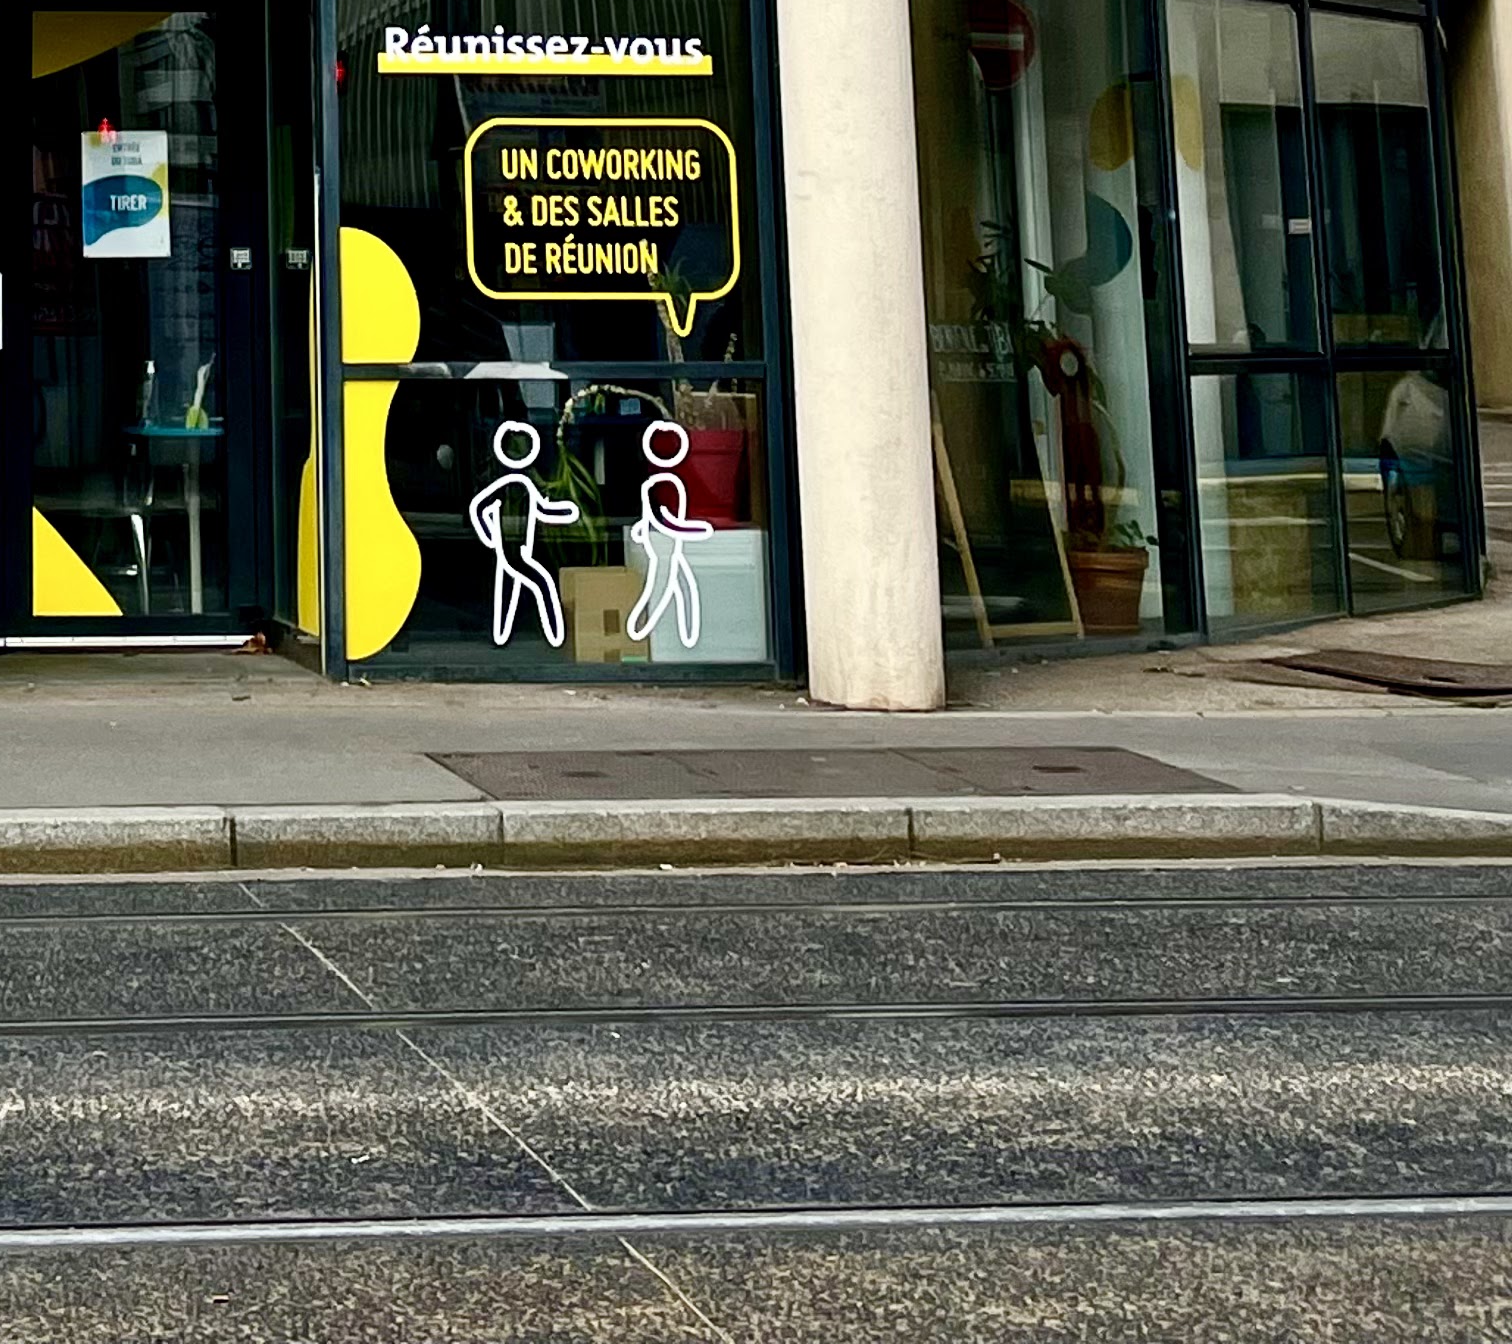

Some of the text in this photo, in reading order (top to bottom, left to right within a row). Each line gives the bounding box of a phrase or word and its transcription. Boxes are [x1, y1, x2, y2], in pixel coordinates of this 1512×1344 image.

[384, 25, 704, 67] Réunissez-vous
[501, 147, 702, 182] UN COWORKING
[109, 194, 147, 211] TIRER
[502, 194, 680, 228] & DES SALLES
[504, 234, 660, 276] DE RÉUNION
